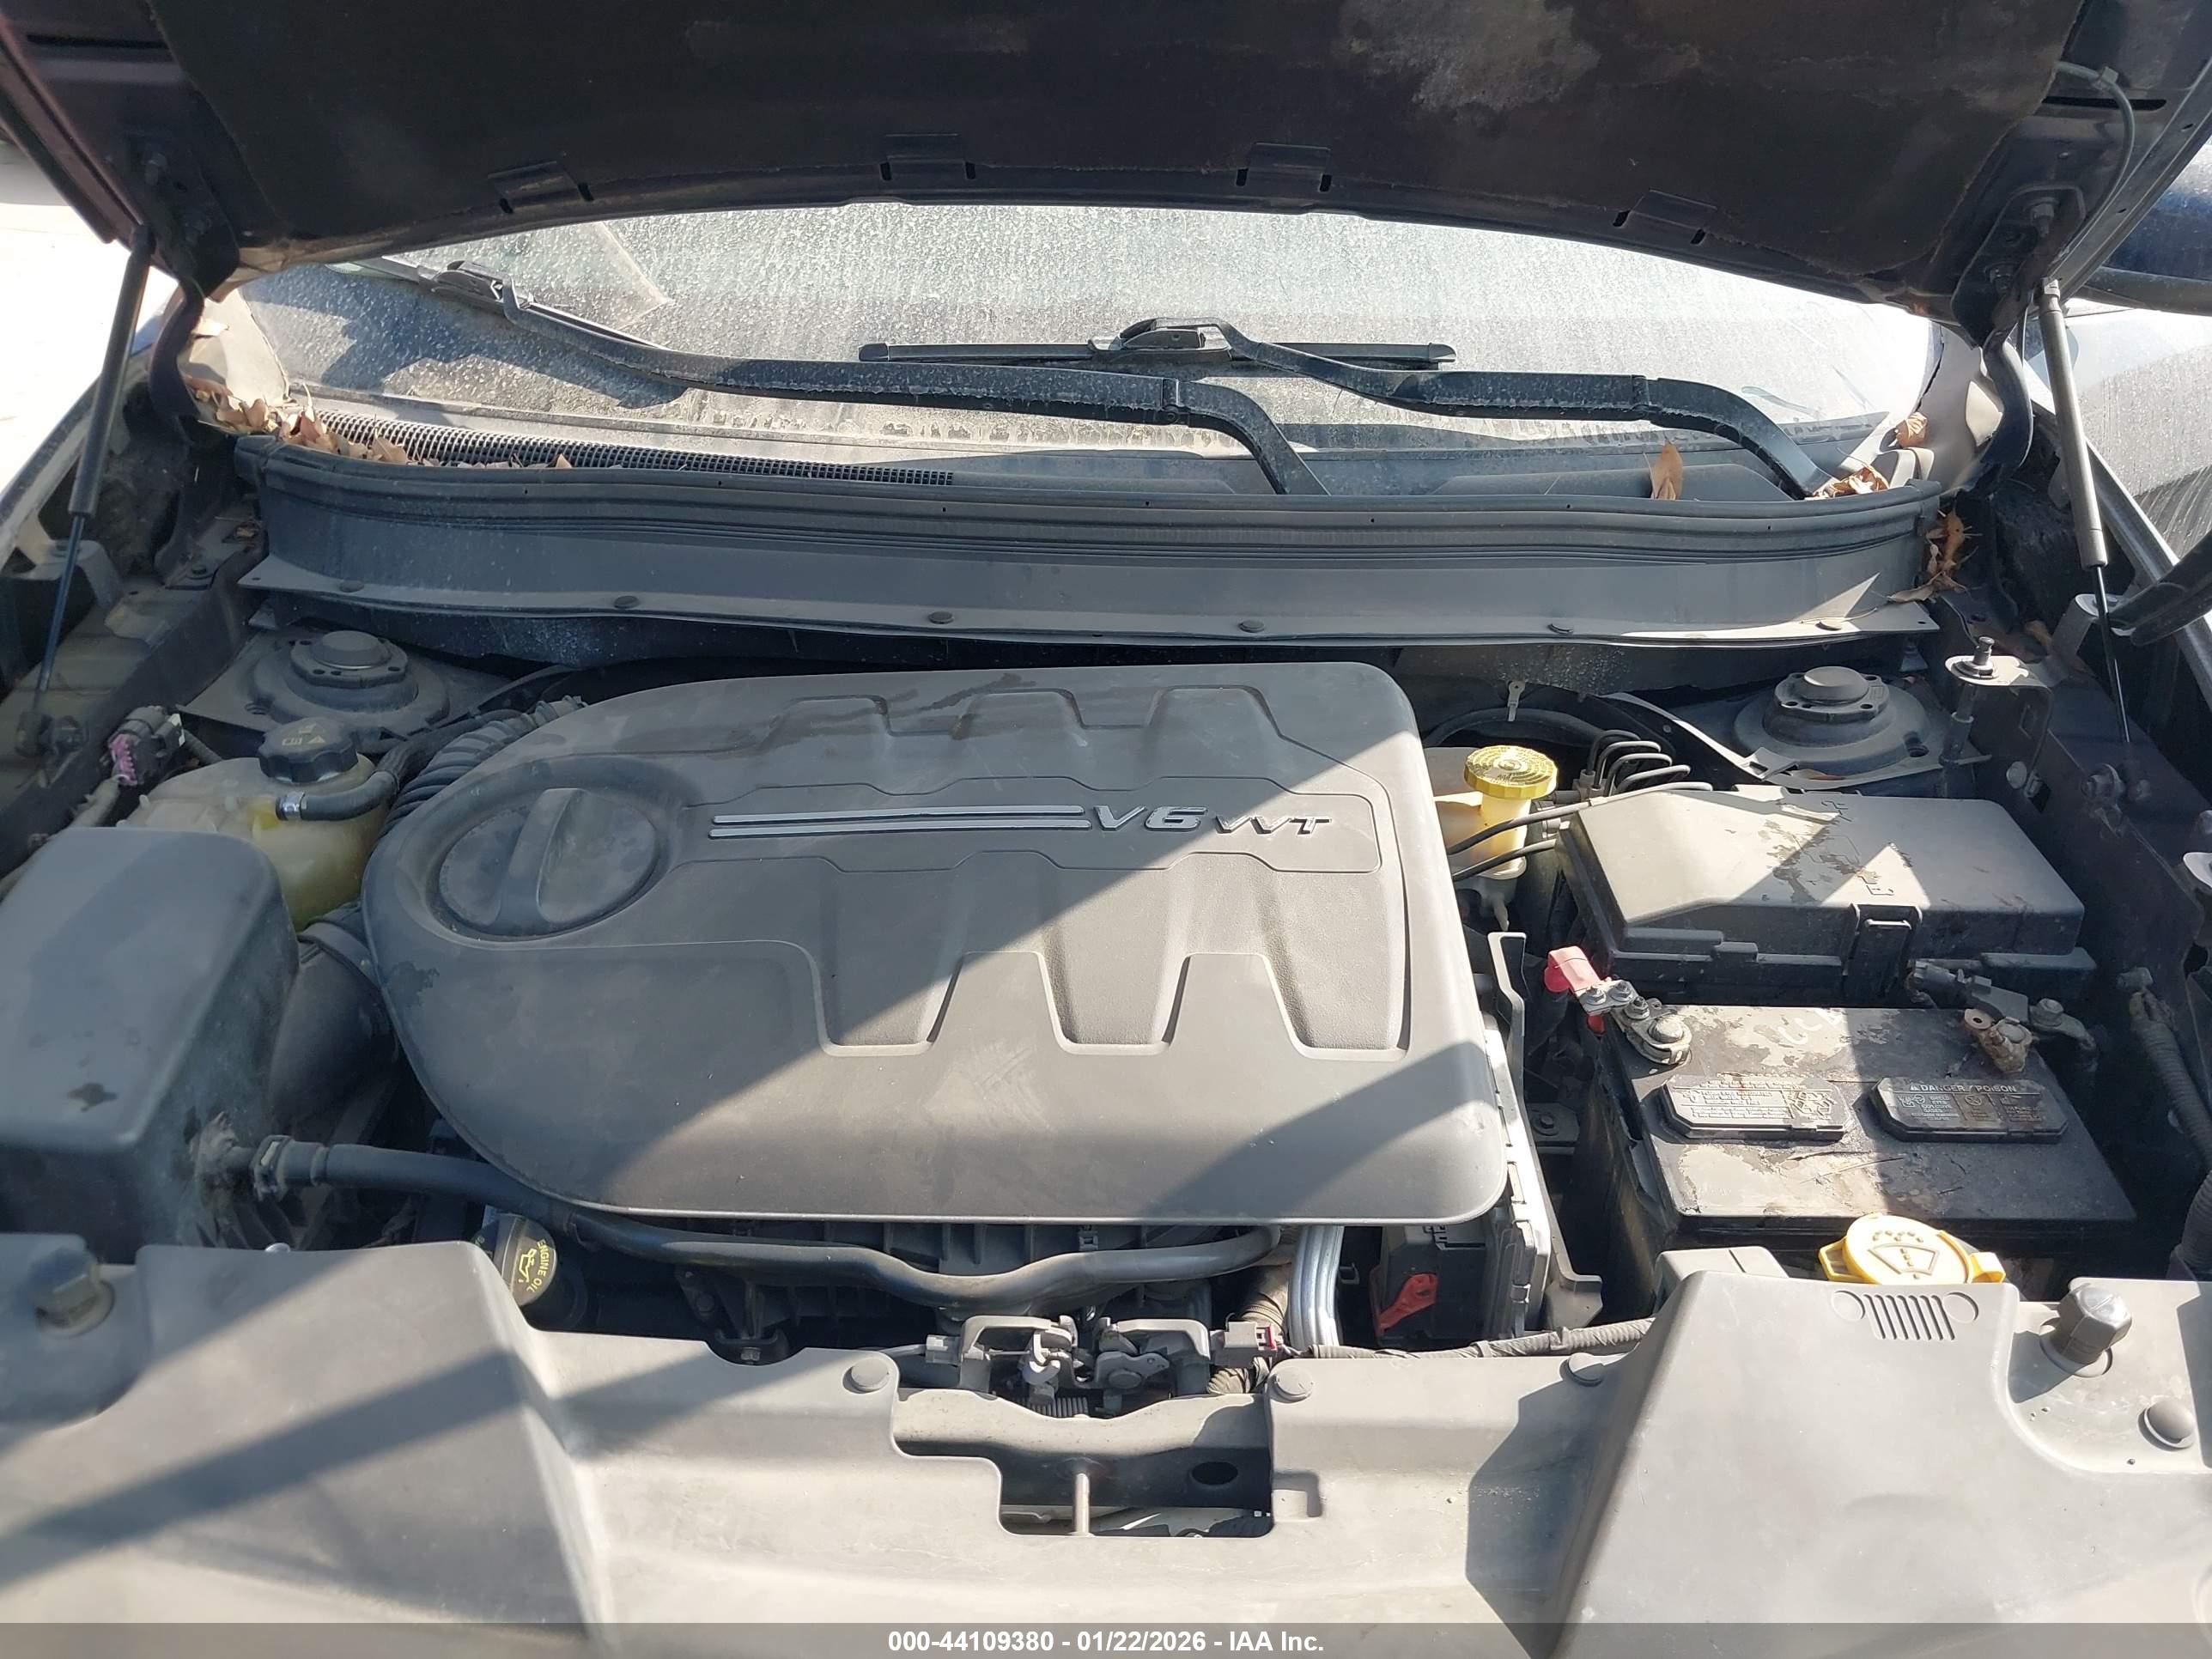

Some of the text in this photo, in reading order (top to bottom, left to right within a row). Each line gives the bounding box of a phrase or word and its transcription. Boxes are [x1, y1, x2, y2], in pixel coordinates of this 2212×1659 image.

[1093, 805, 1209, 831] V6
[526, 1238, 550, 1292] ENGINE OIL
